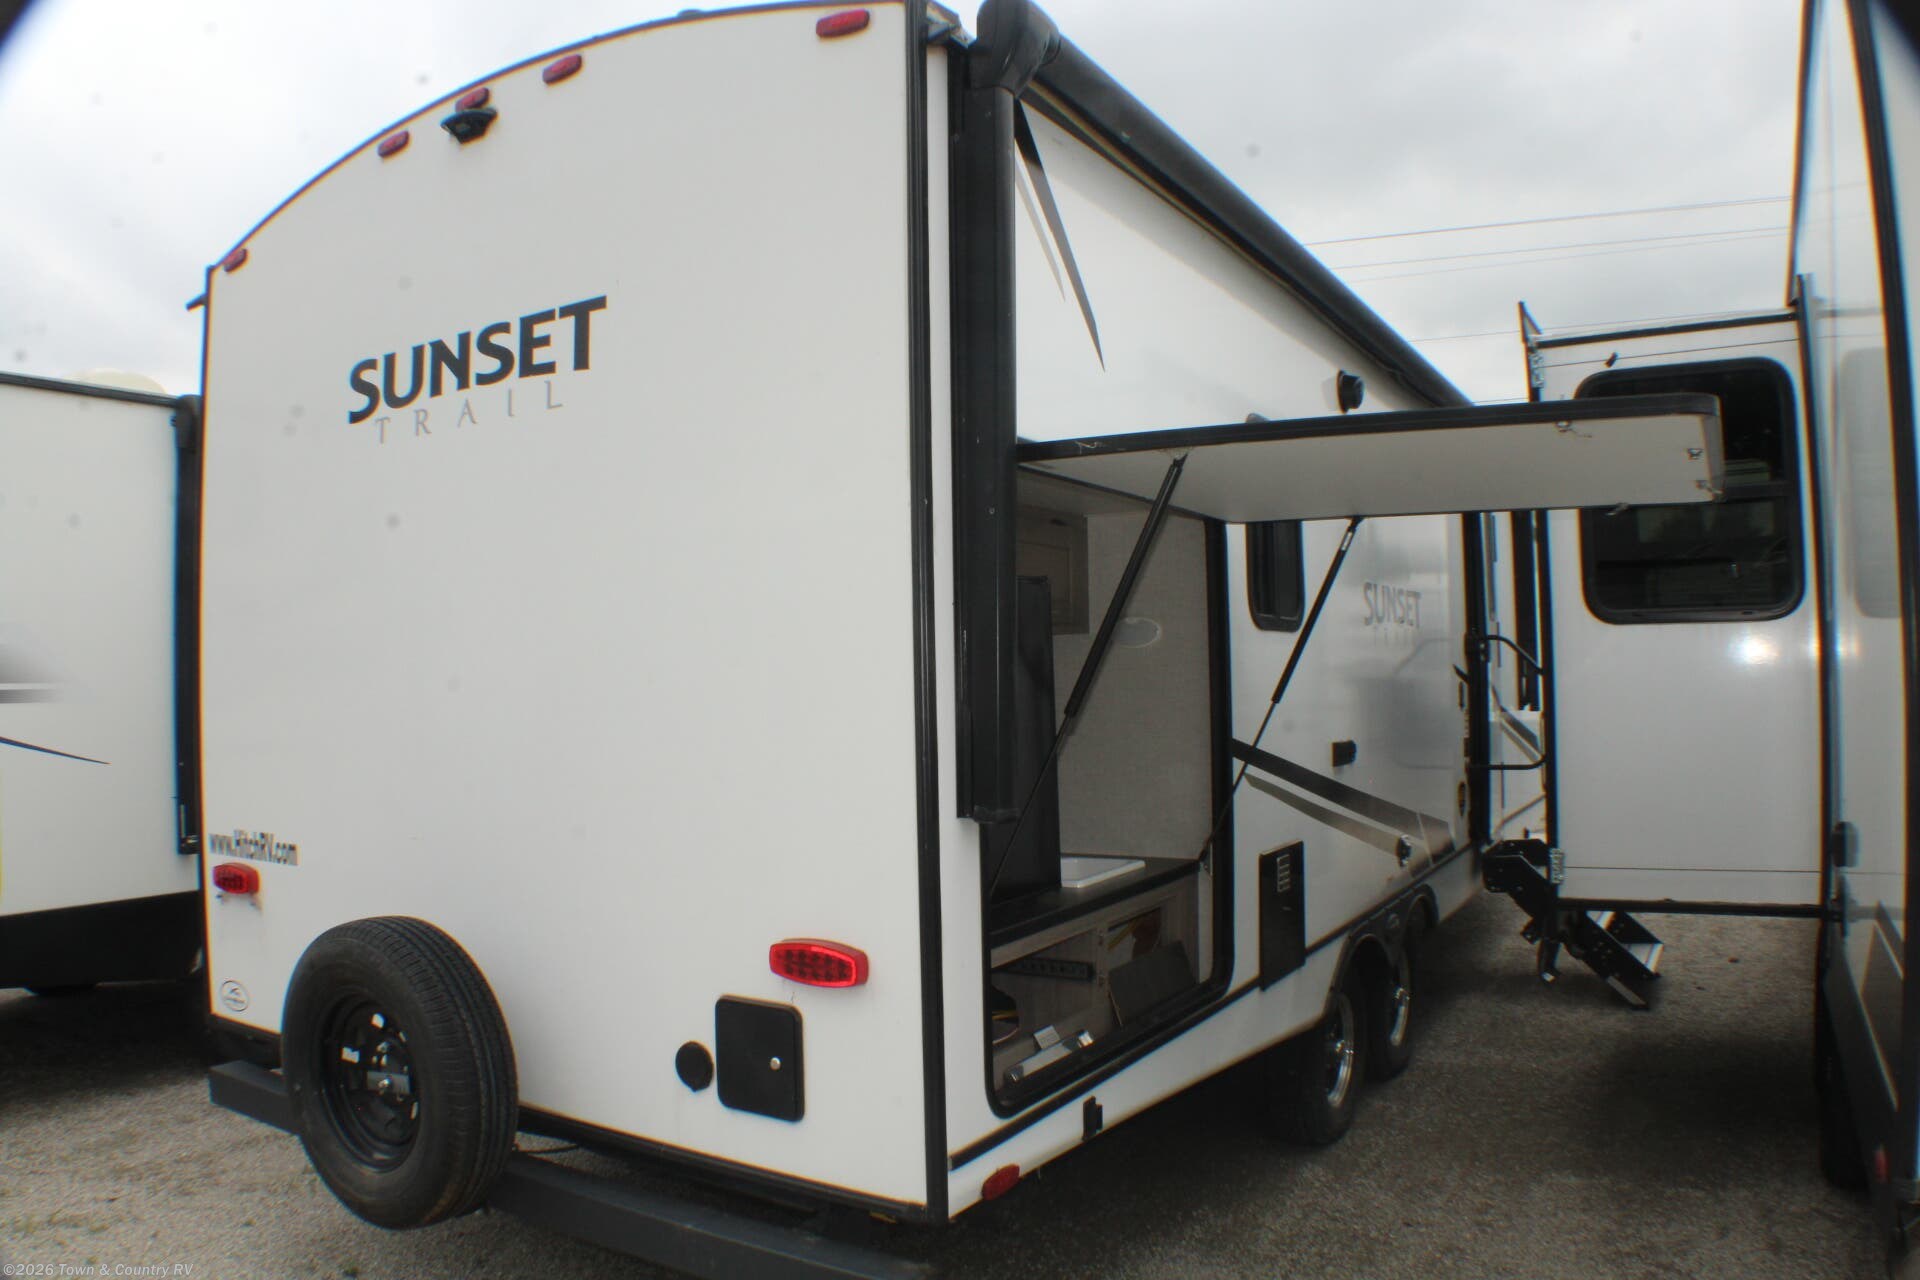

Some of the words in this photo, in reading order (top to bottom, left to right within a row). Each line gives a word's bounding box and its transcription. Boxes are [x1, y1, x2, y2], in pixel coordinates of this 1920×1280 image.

[348, 294, 608, 425] SUNSET
[374, 380, 563, 445] TRAIL
[1363, 581, 1422, 629] SUNSET
